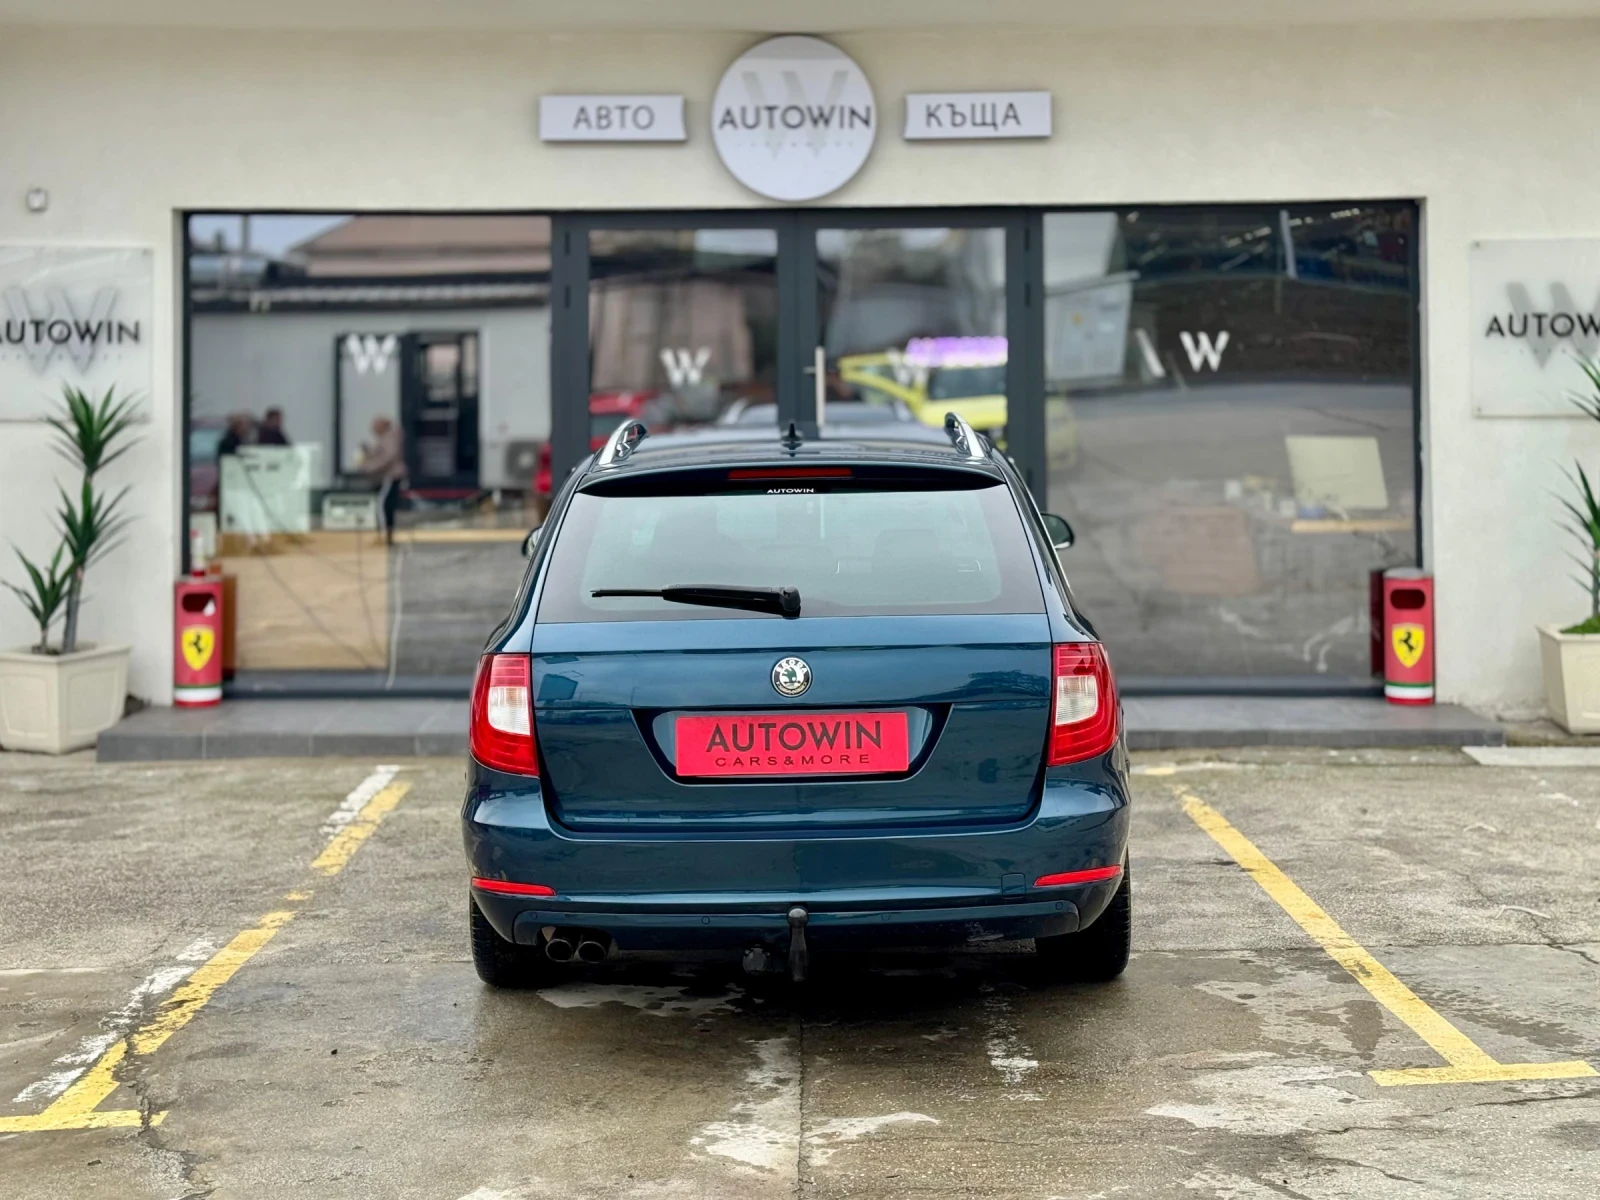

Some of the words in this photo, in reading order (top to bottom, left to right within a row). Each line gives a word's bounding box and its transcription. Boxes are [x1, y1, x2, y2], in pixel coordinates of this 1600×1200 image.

[573, 104, 654, 130] АВТО
[719, 105, 872, 130] AUTOWIN
[926, 101, 1021, 133] КЪЩА
[0, 319, 140, 344] UTOWIN
[1180, 331, 1229, 372] W
[706, 720, 881, 752] AUTOWIN
[715, 754, 870, 767] CARS&MORE
